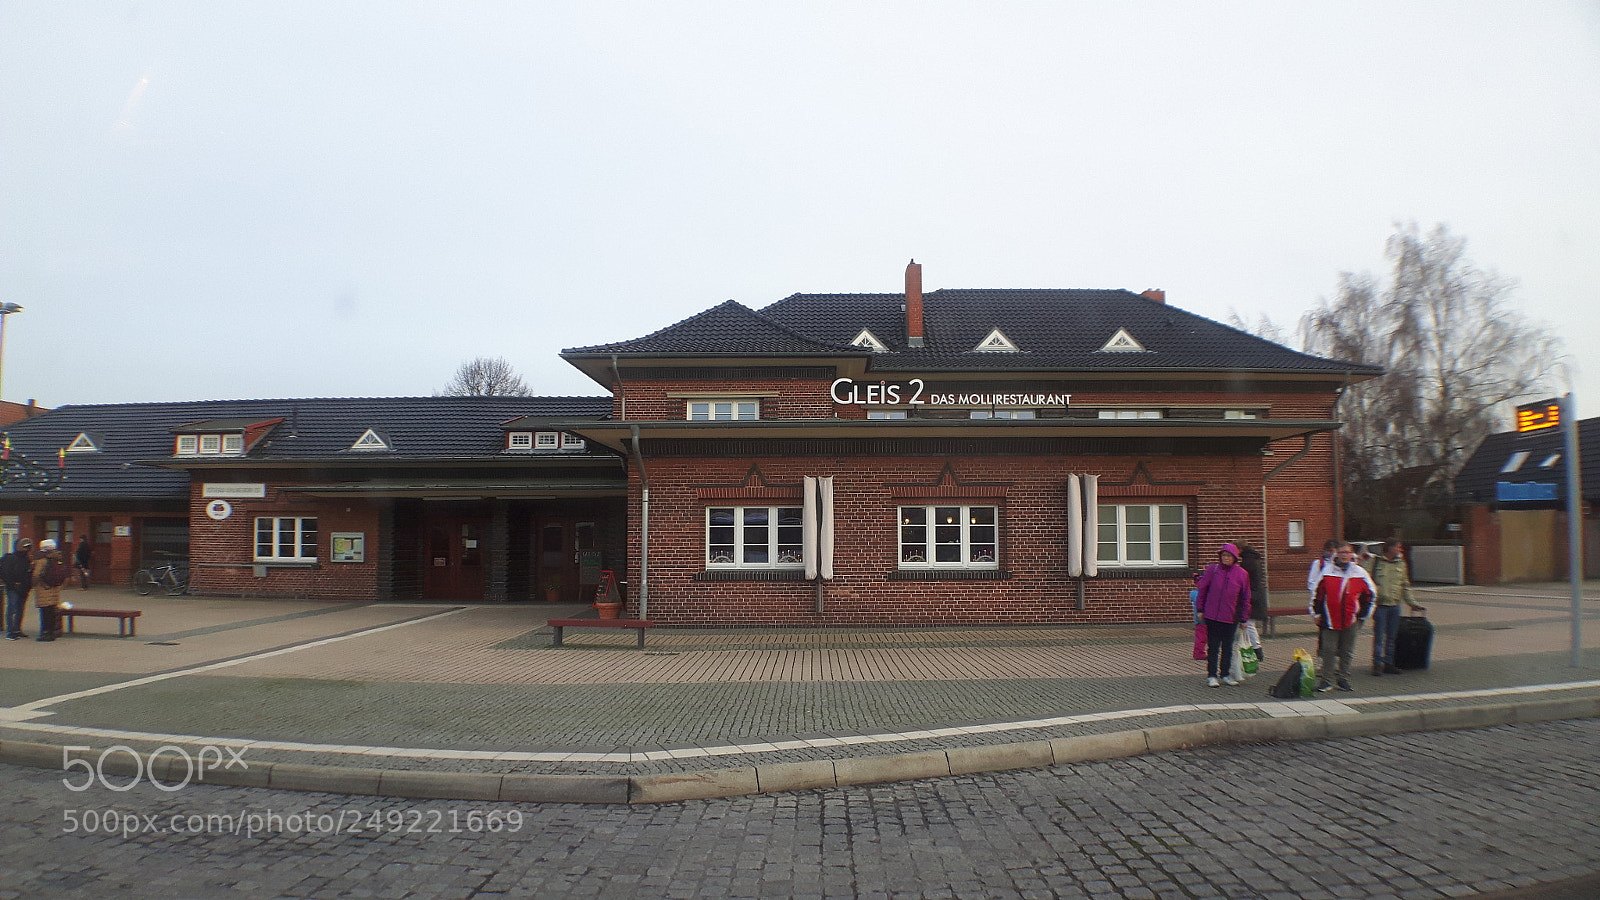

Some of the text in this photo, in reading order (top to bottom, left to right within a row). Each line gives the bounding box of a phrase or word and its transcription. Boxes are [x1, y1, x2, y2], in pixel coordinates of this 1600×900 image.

[908, 378, 925, 405] 2
[930, 393, 956, 405] DAS
[958, 393, 1072, 405] MOLLIRESTAURANT
